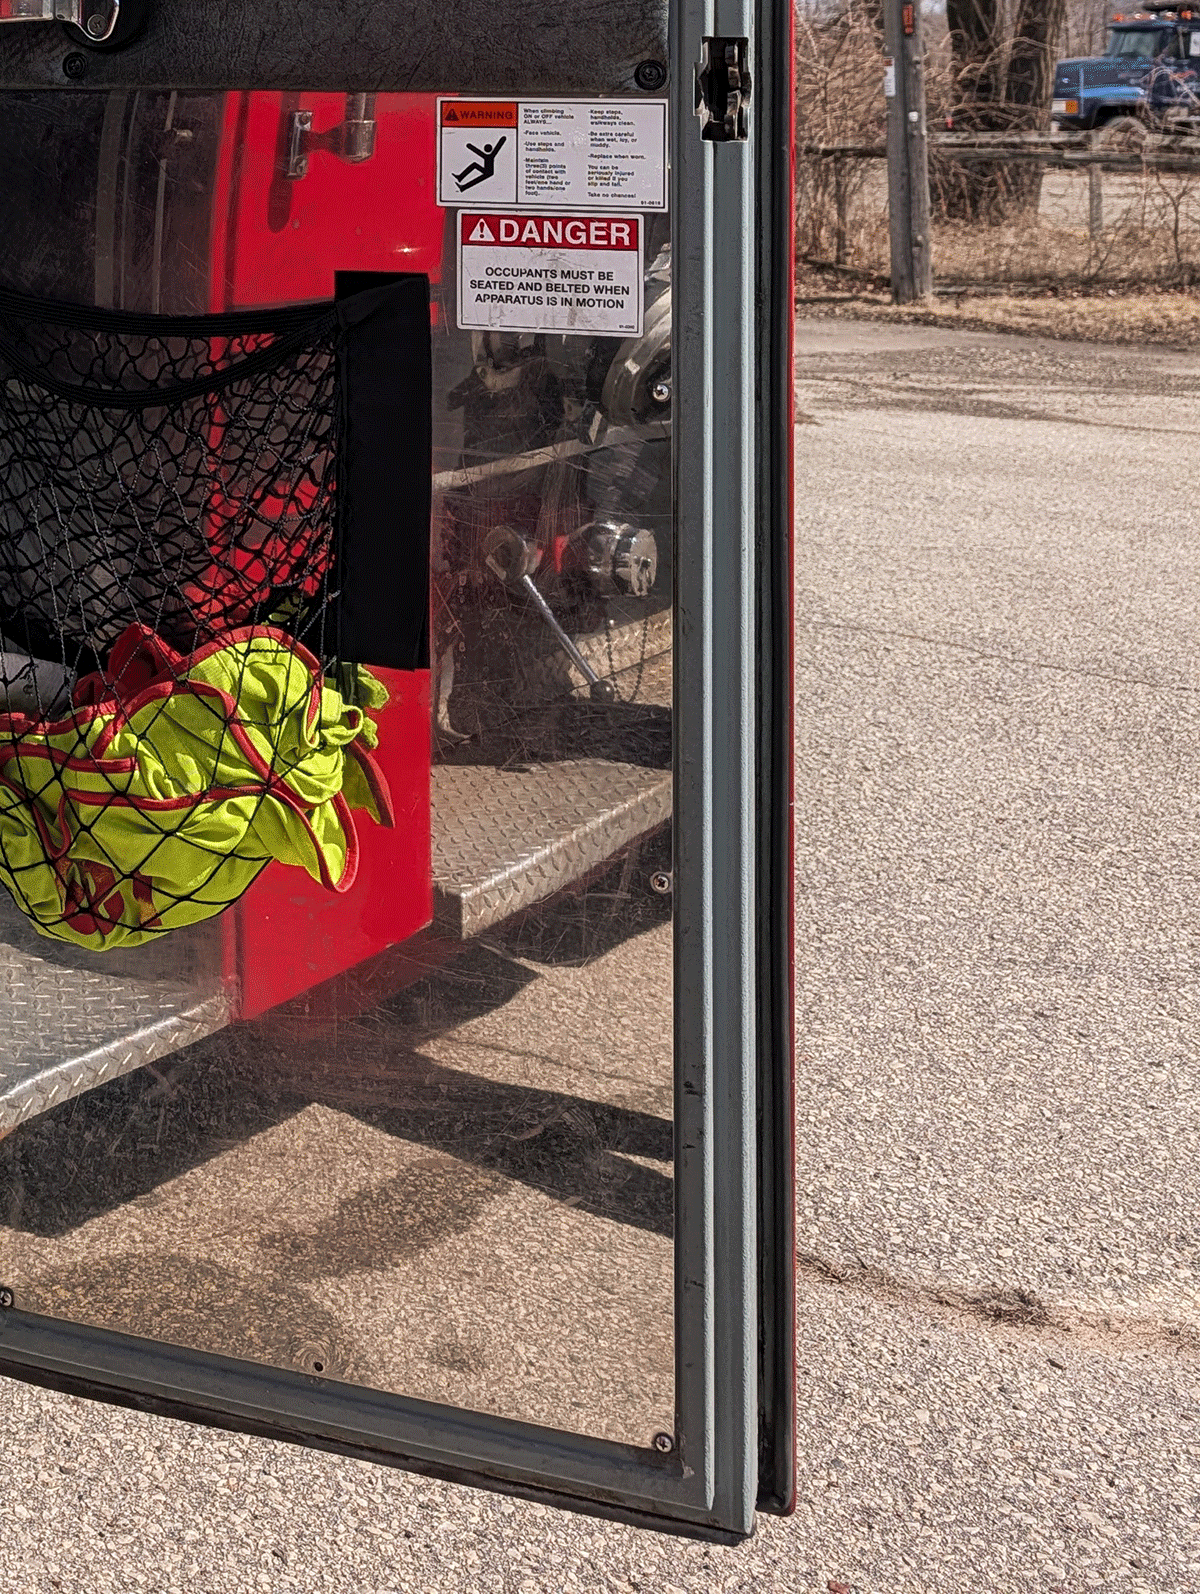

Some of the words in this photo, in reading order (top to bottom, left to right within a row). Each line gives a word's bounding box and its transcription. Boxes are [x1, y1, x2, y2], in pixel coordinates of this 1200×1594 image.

[460, 110, 513, 120] WARNING
[499, 219, 631, 246] DANGER
[485, 266, 558, 279] OCCUPANTS
[560, 269, 594, 281] MUST
[597, 271, 614, 281] BE
[470, 279, 514, 291] SEATED
[517, 282, 543, 292] AND
[546, 283, 590, 294] BELTED
[593, 284, 630, 295] WHEN
[475, 293, 544, 306] APPARATUS
[547, 296, 558, 306] IS
[560, 297, 573, 307] IN
[575, 297, 625, 309] MOTION
